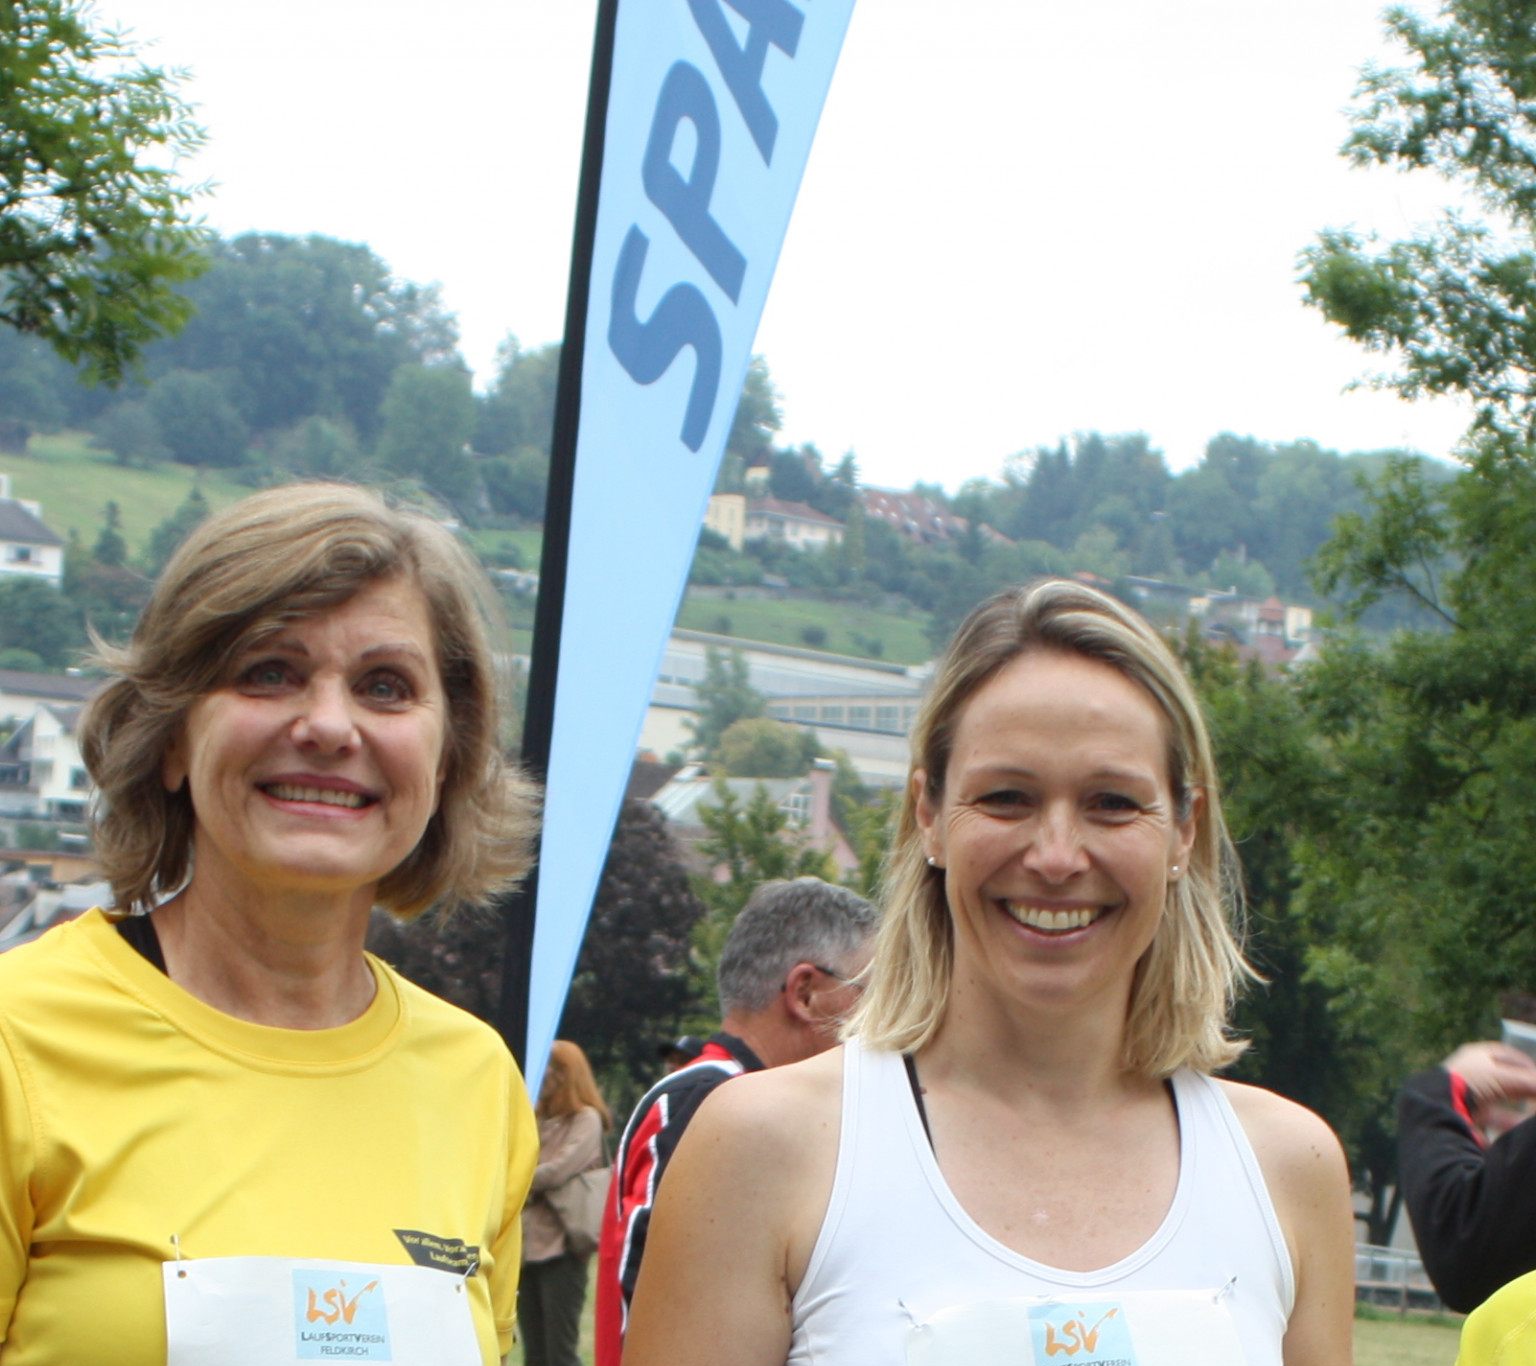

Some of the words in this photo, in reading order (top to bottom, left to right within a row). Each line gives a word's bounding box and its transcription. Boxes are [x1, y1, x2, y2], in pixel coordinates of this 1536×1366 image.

[306, 1279, 379, 1326] LSV
[320, 1346, 369, 1356] FELDKIRCH
[1045, 1307, 1118, 1357] LSV
